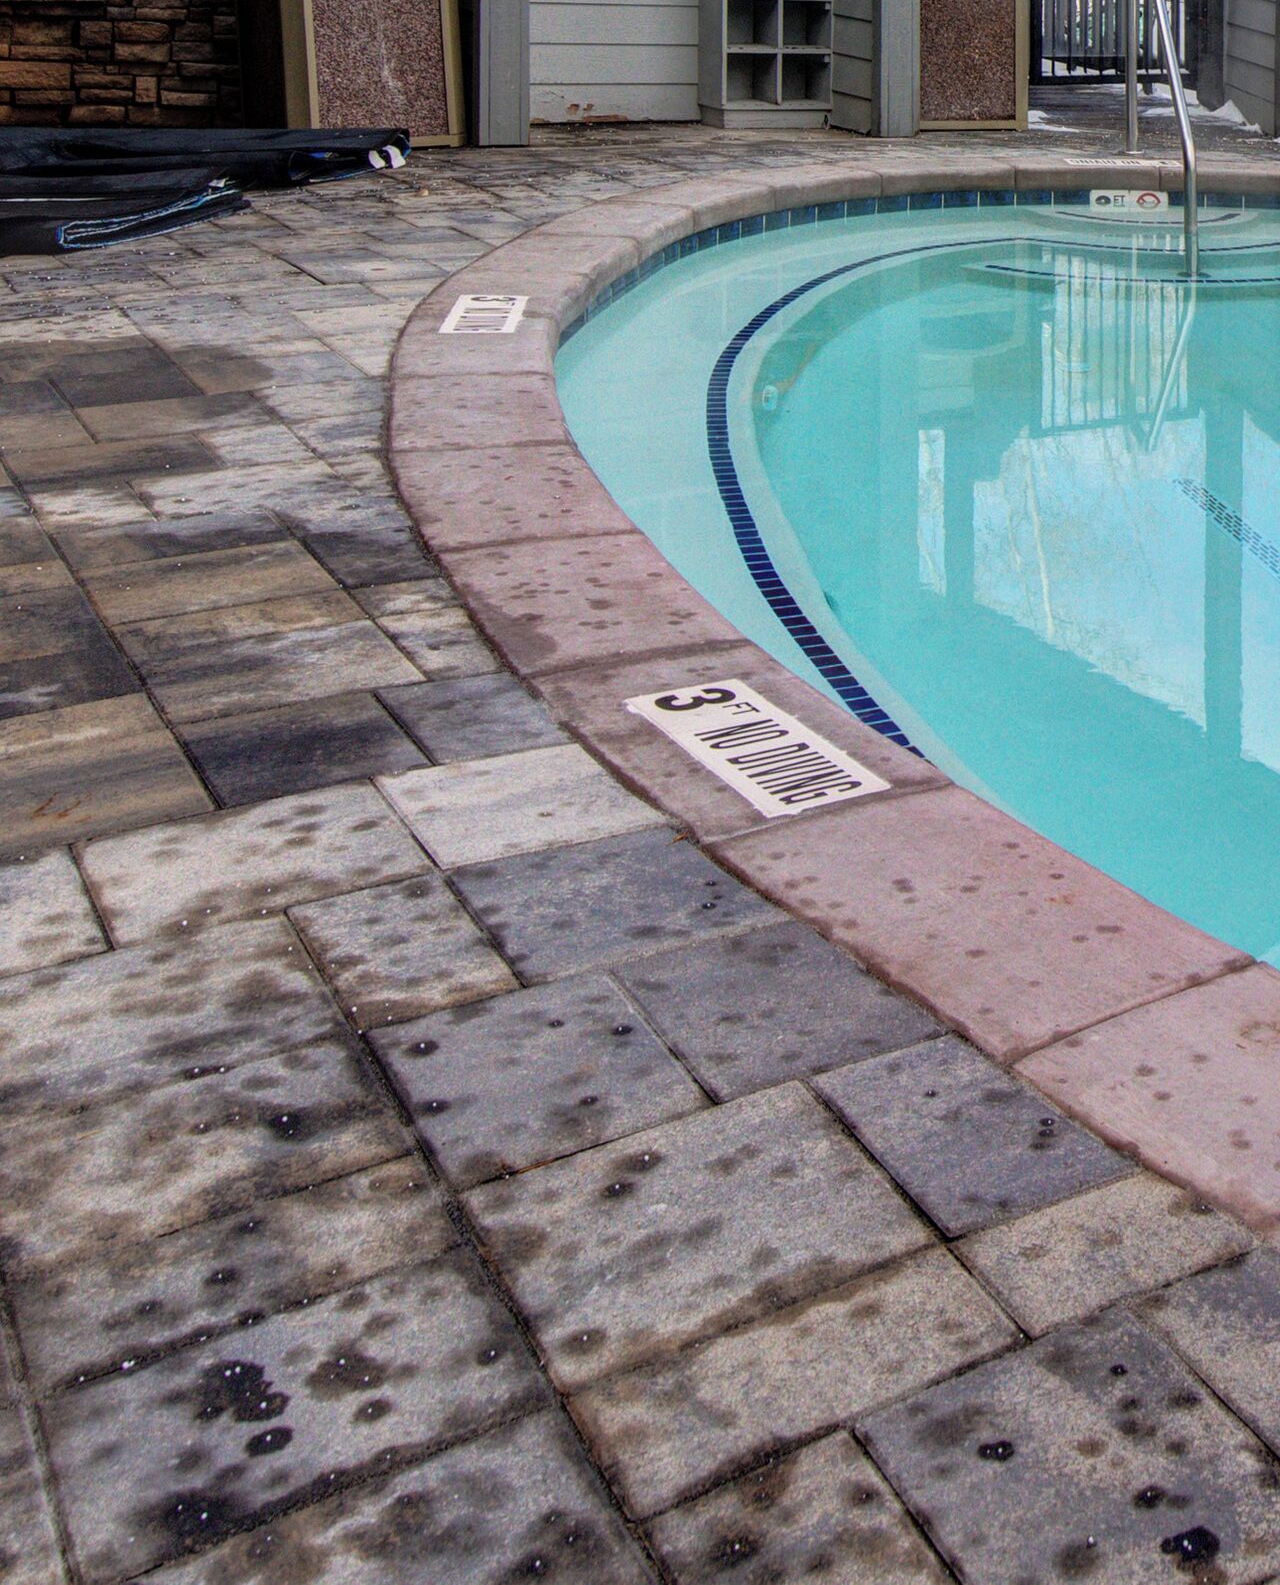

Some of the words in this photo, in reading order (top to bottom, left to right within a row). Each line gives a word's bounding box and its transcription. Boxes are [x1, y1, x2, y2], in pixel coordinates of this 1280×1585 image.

[654, 687, 737, 712] 3
[722, 702, 760, 716] FT
[693, 718, 790, 750] NO
[725, 742, 863, 806] DIVING
